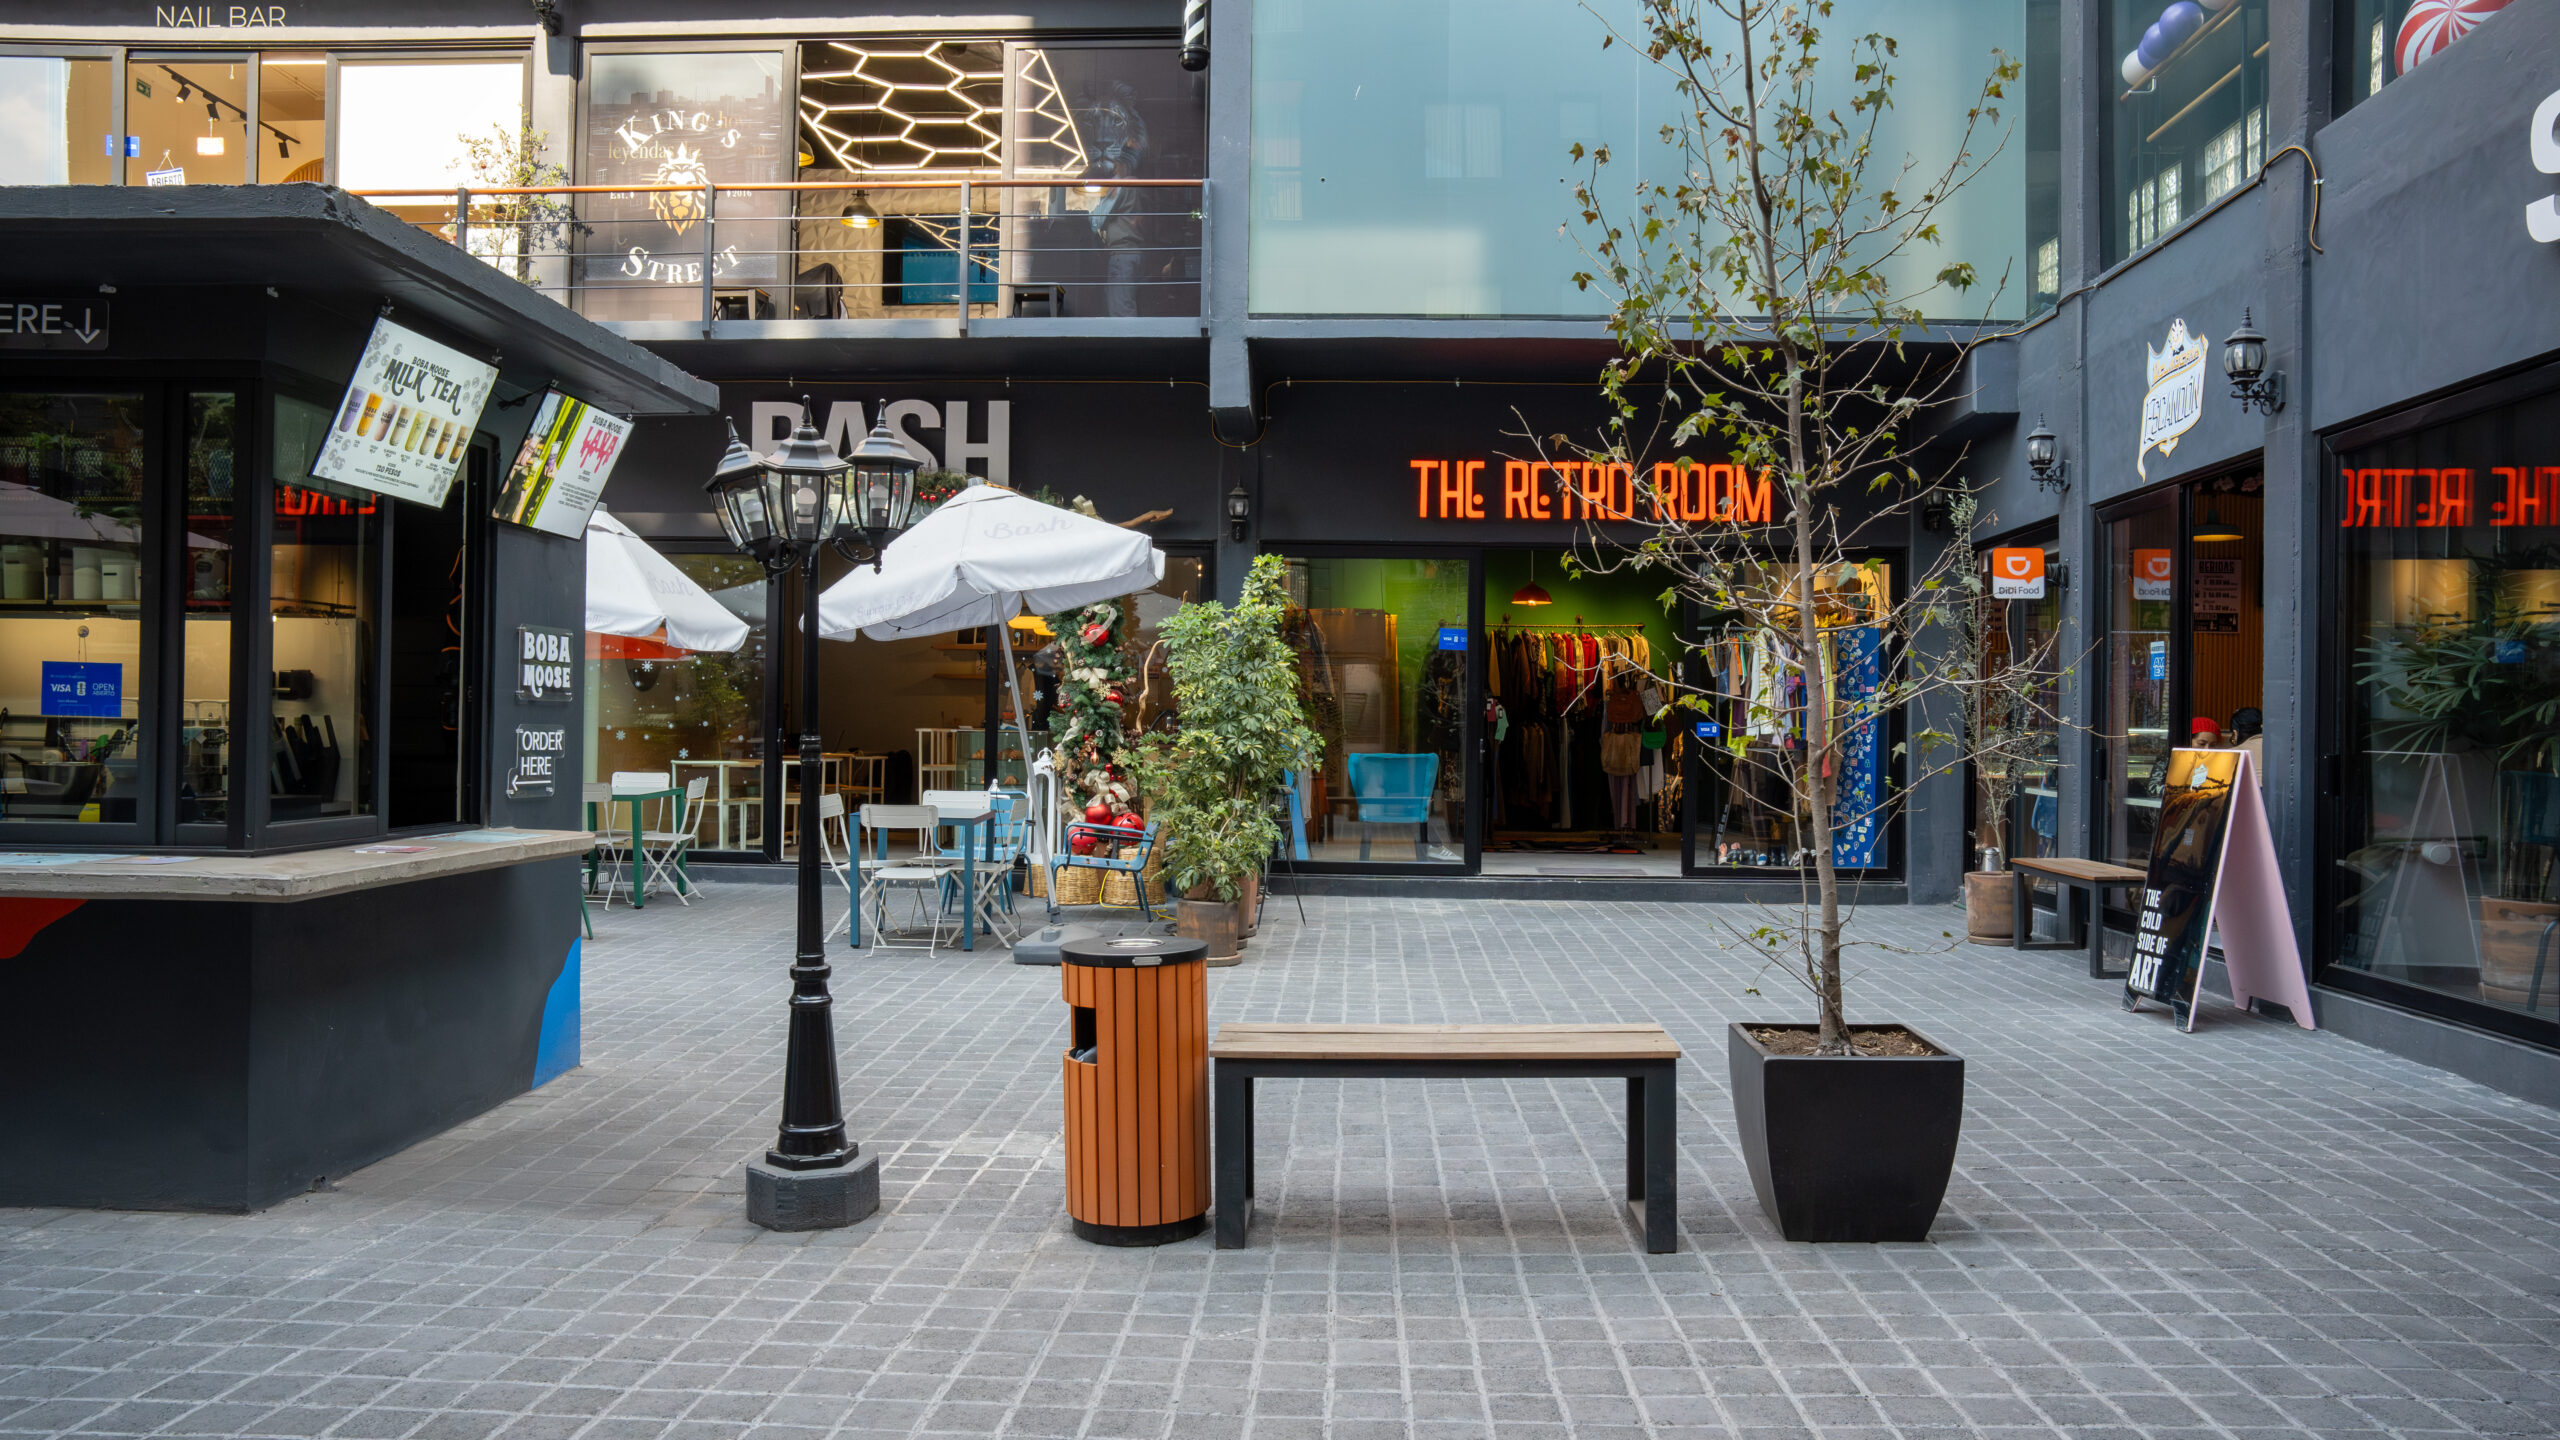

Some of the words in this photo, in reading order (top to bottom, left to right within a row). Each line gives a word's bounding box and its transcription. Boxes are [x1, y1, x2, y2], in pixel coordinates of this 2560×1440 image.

[157, 5, 221, 28] NAIL
[229, 6, 286, 28] BAR
[614, 109, 741, 151] KING'S
[620, 244, 741, 284] STREET
[412, 356, 429, 370] BOBA
[429, 363, 451, 378] MOOSE
[382, 358, 429, 403] MILK
[430, 375, 463, 416] TEA
[751, 398, 1010, 487] BASH
[1410, 459, 1485, 519] THE
[1505, 460, 1633, 520] RETRO
[1653, 462, 1771, 523] ROOM
[984, 515, 1074, 540] Bash
[1998, 586, 2018, 595] DiDi
[2018, 586, 2040, 595] Food
[523, 631, 571, 663] BOBA
[50, 683, 71, 693] VISA
[92, 683, 115, 692] OPEN
[523, 664, 571, 698] MOOSE
[521, 730, 563, 751] ORDER
[520, 756, 552, 776] HERE
[2145, 888, 2162, 908] THE
[2140, 910, 2162, 931] COLD
[2137, 931, 2157, 953] SIDE
[2155, 936, 2169, 955] OF
[2128, 952, 2163, 992] ART
